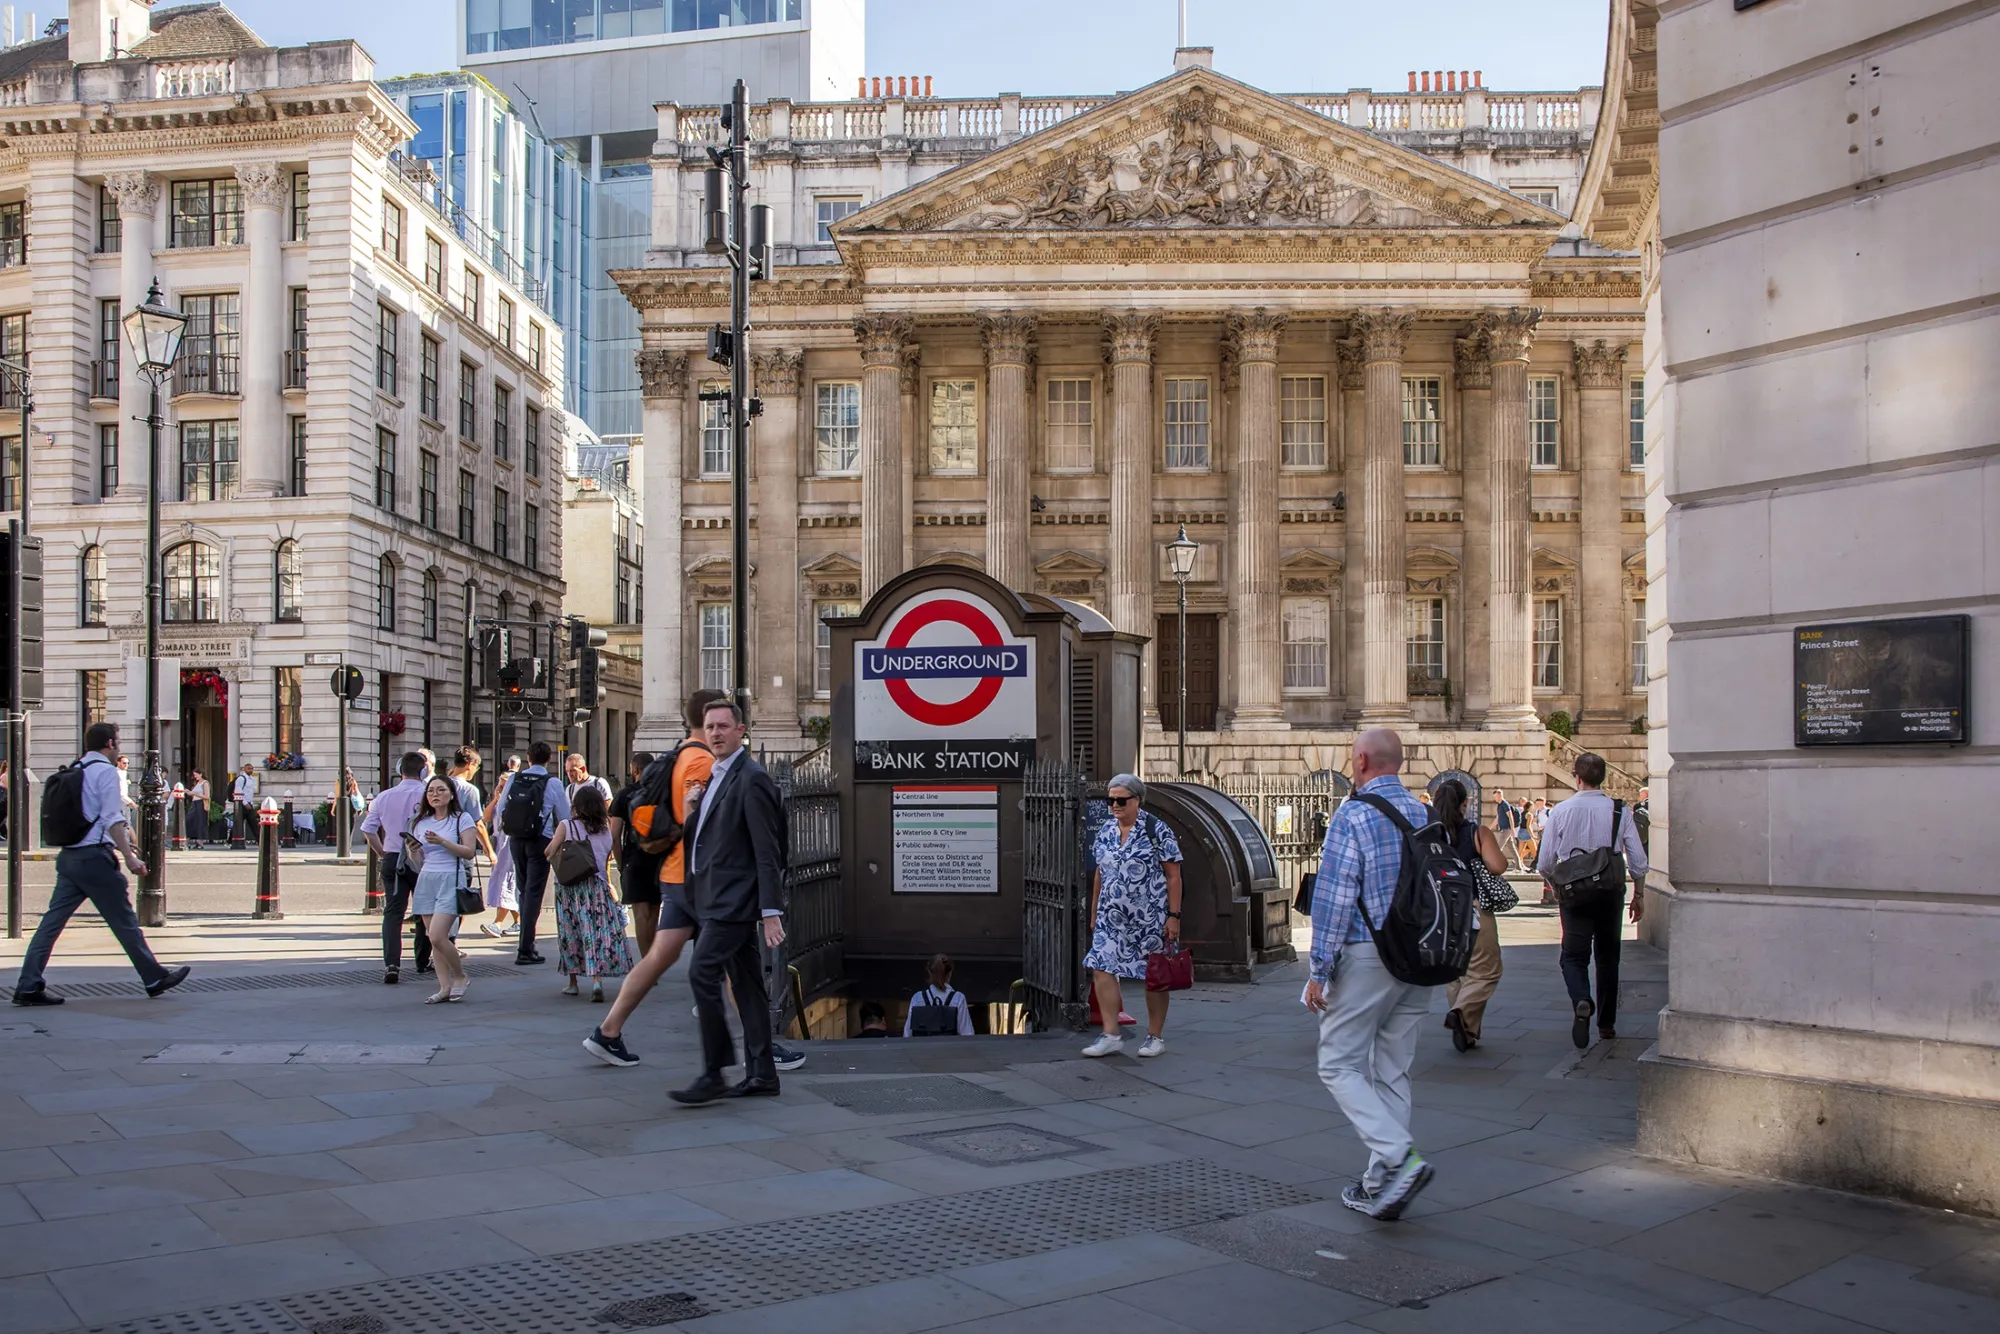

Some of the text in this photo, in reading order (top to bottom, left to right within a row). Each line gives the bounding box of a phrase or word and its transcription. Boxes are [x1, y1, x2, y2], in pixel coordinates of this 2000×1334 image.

[1800, 632, 1824, 640] BANK
[158, 643, 197, 651] OMBARD
[200, 642, 231, 651] STREET
[1800, 640, 1859, 650] Princes Street
[870, 652, 1019, 673] UNDERGROUND
[872, 752, 1019, 769] BANK STATION
